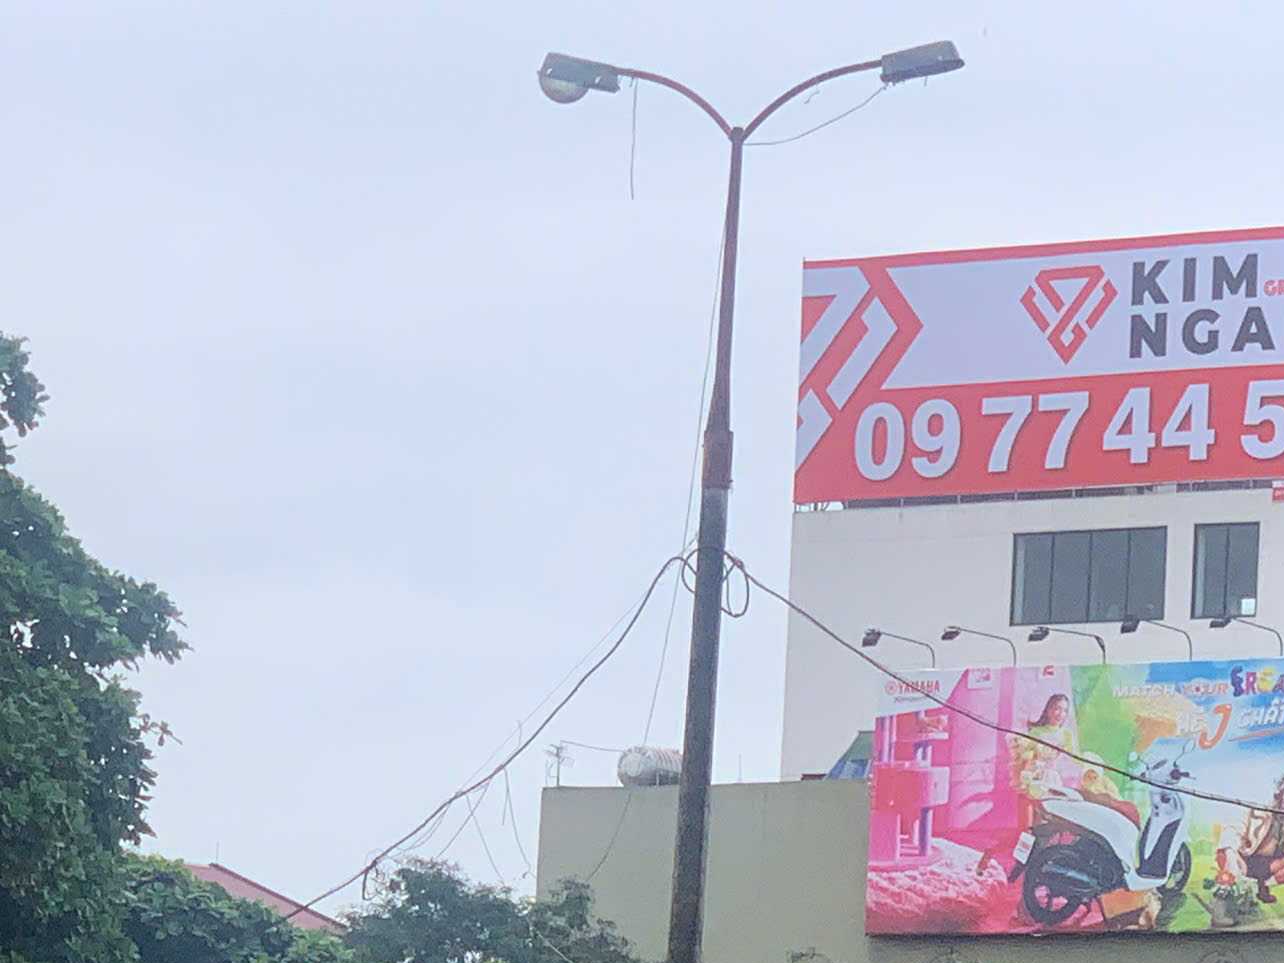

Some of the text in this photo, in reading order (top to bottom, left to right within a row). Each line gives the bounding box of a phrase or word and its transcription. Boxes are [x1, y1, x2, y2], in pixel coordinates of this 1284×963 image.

[1132, 252, 1258, 306] KIM
[855, 398, 961, 481] 09
[980, 391, 1089, 472] 77
[1102, 384, 1215, 465] 44
[898, 680, 940, 694] YAMAHA
